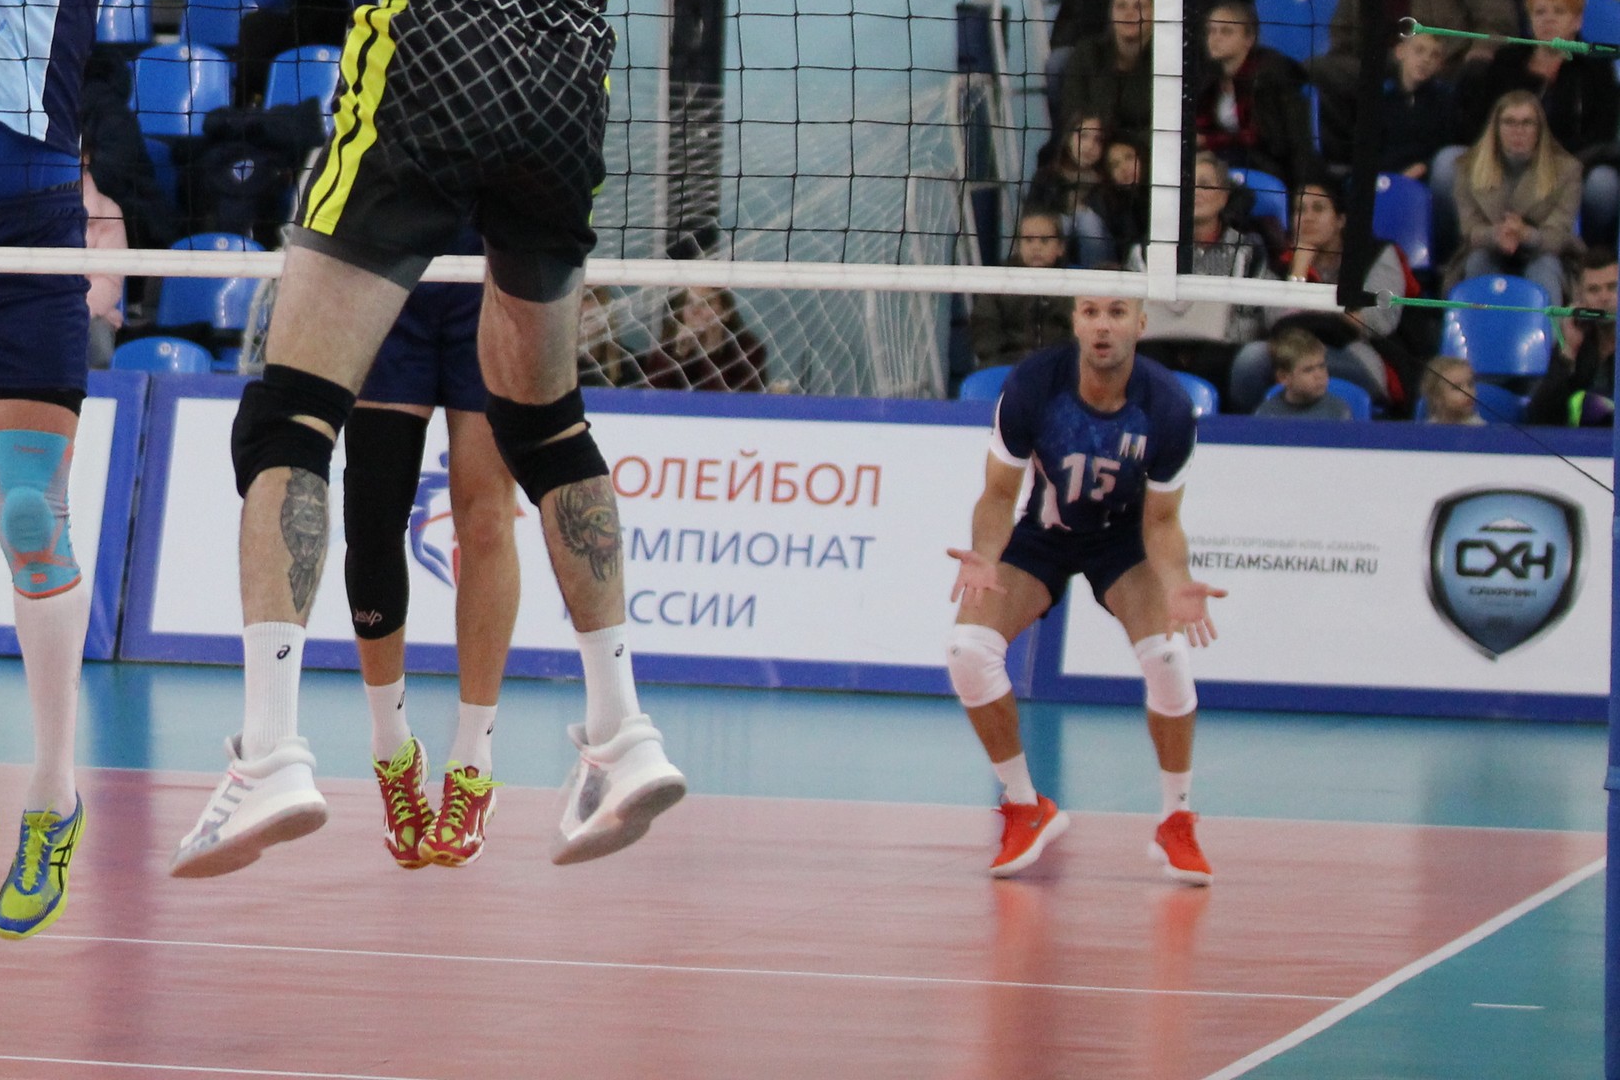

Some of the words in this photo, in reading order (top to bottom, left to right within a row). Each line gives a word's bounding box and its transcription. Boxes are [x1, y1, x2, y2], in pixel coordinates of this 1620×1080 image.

[611, 448, 882, 507] ОЛЕЙБОЛ
[1061, 452, 1121, 504] 15
[620, 525, 877, 570] МПИОНАТ
[1187, 551, 1379, 575] NETEAMSAKHALIN.RU
[626, 590, 758, 628] ССИИ
